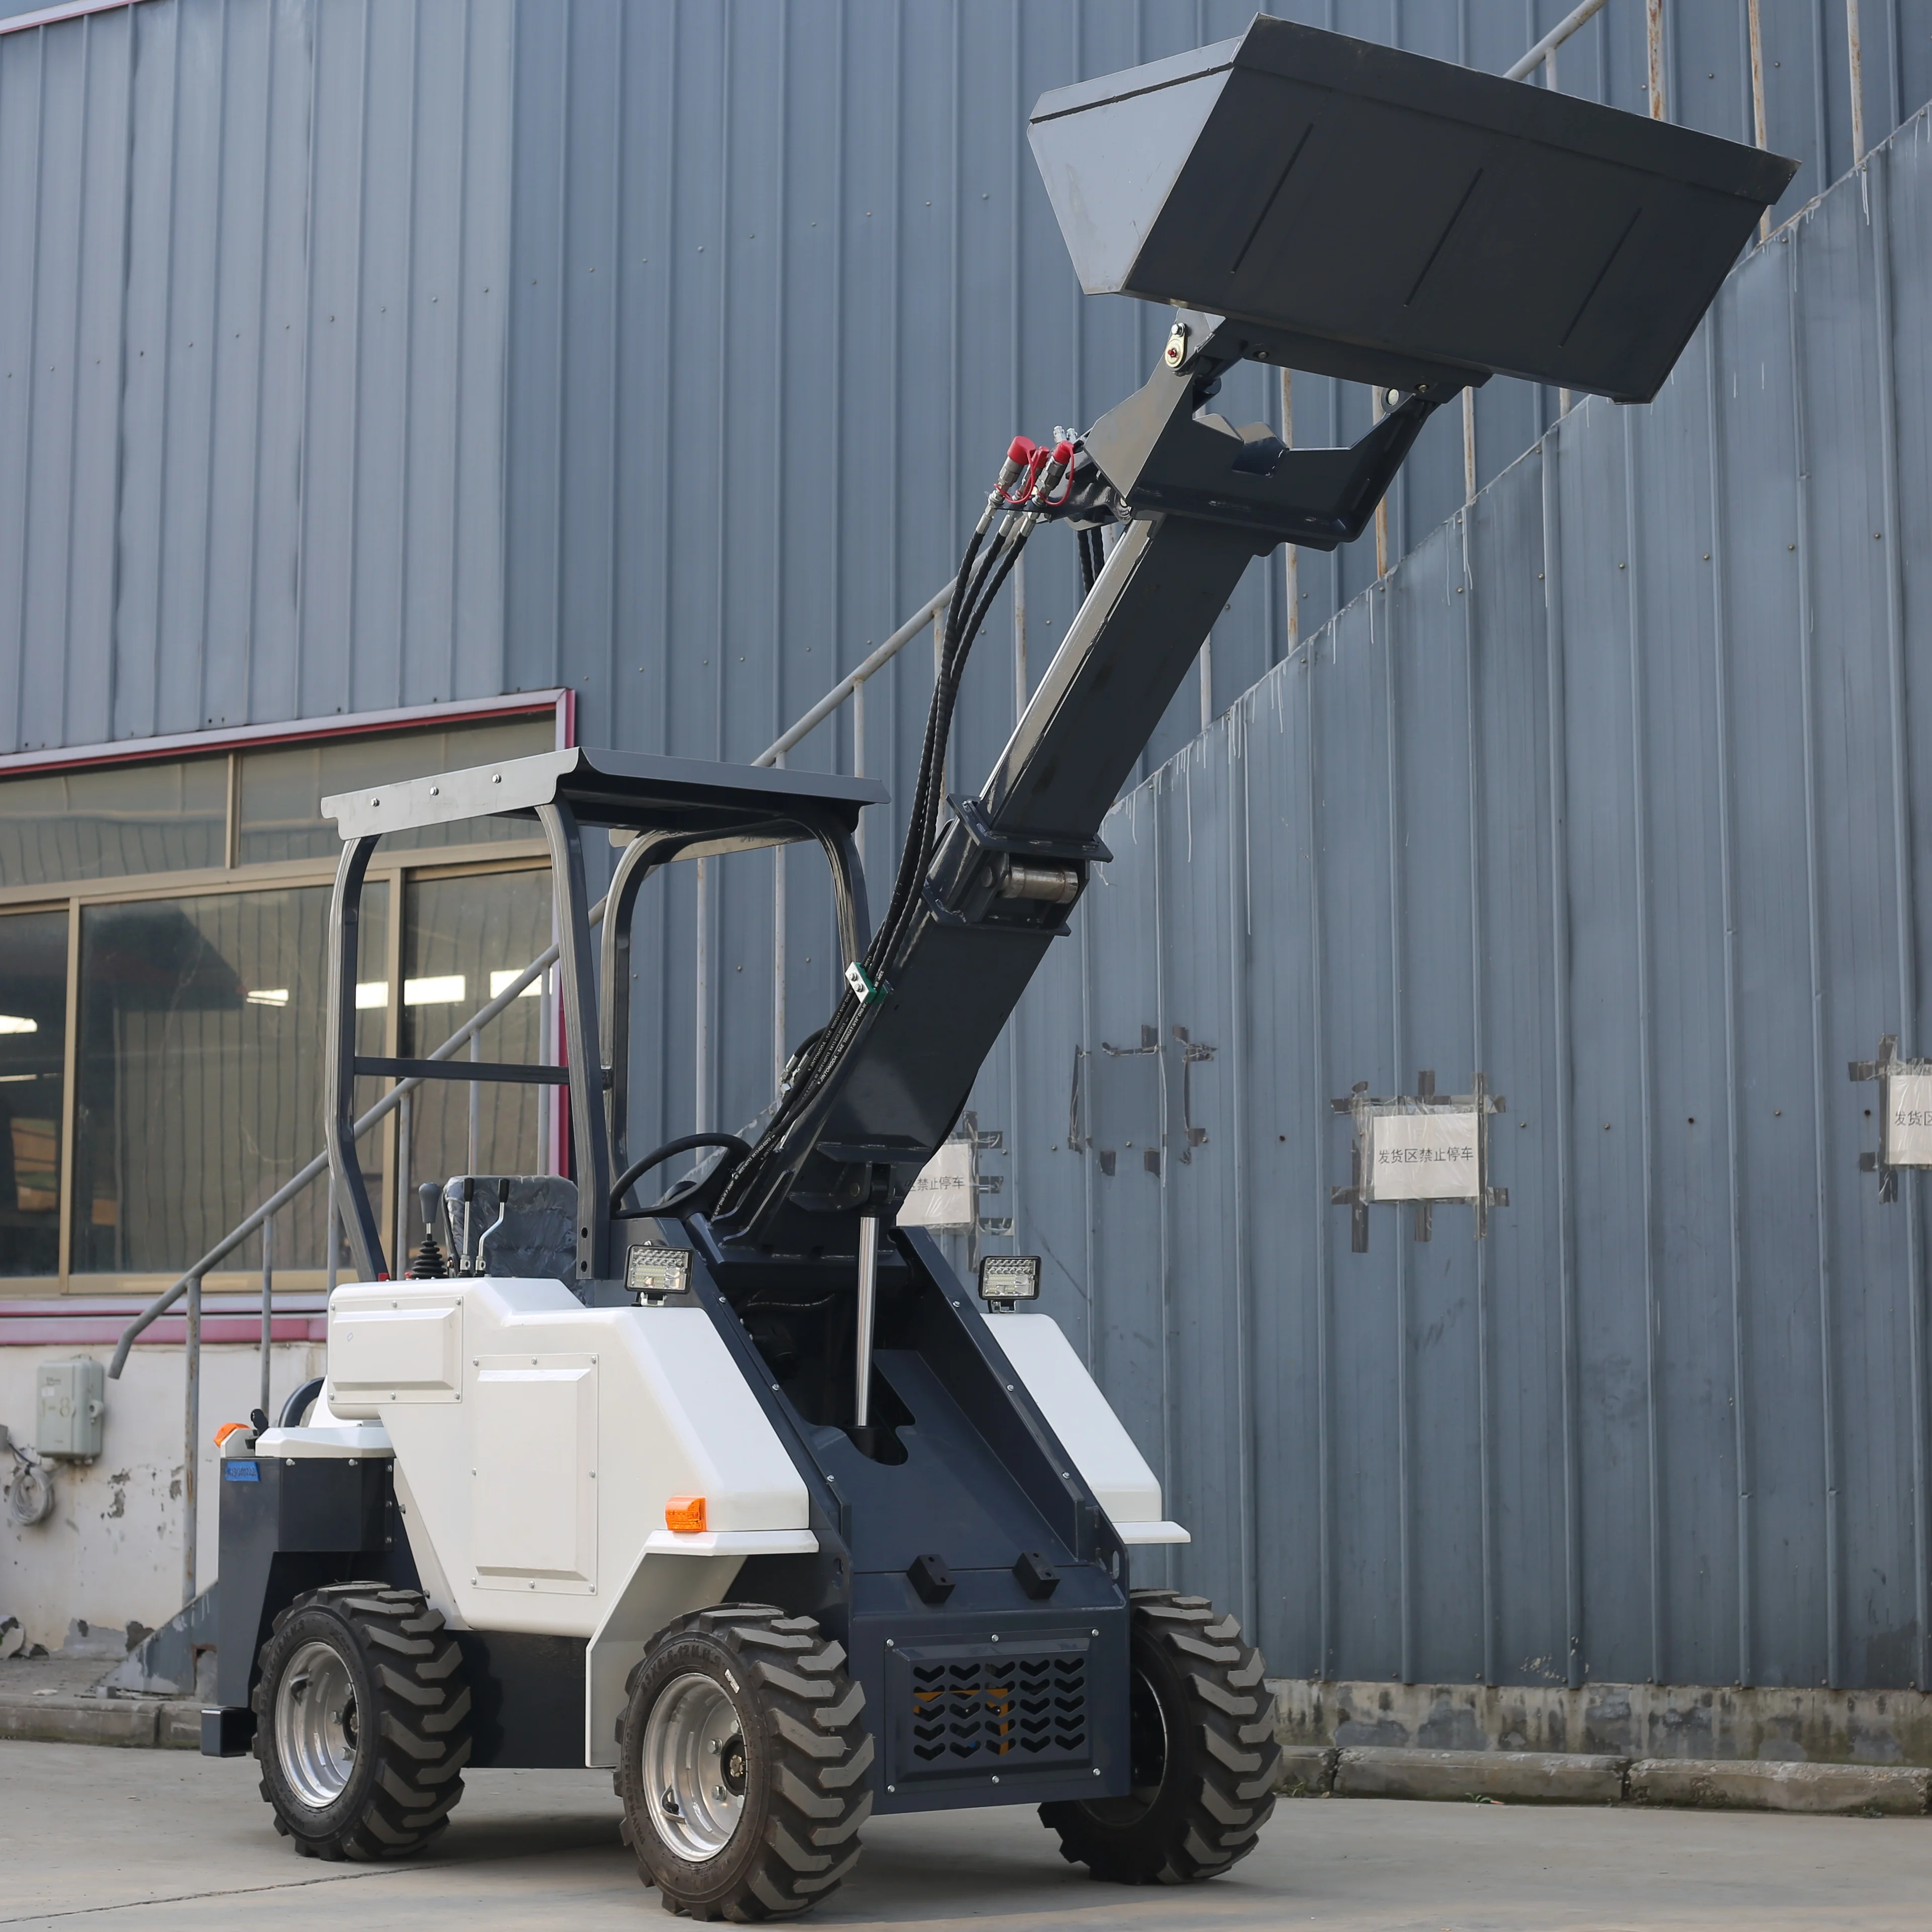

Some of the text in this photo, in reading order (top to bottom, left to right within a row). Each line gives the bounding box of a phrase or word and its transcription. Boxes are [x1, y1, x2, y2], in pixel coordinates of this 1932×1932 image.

[811, 1042, 827, 1068] JINTONGDA
[820, 1056, 838, 1082] JINTONGDA
[1379, 1147, 1474, 1164] 发货区禁止停车
[910, 1176, 965, 1192] 禁止停车
